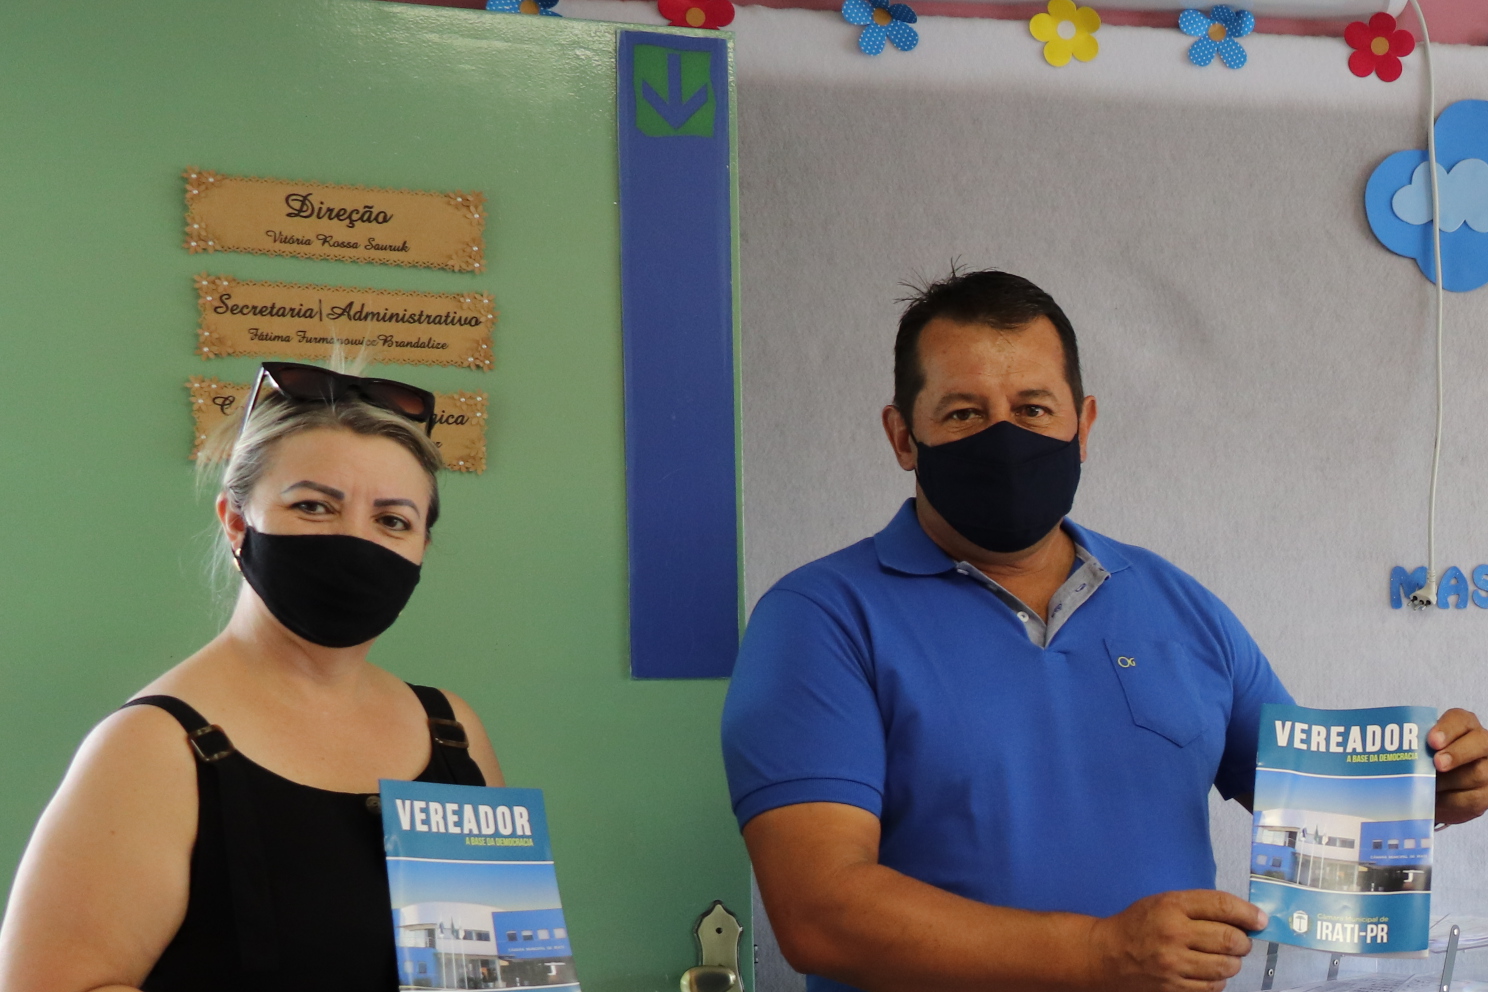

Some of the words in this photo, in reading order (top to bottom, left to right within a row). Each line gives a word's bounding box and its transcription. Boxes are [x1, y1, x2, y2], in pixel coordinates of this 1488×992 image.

[285, 193, 393, 228] Direção
[266, 230, 314, 246] Vitória
[316, 234, 360, 248] Rossa
[326, 301, 482, 327] Administrativo
[248, 328, 293, 343] Fátima
[377, 334, 448, 350] Brandalize
[1274, 720, 1419, 753] VEREADOR
[1352, 754, 1369, 762] BASE
[1369, 754, 1378, 762] DA
[395, 798, 532, 836] VEREADOR
[1316, 921, 1388, 944] IRATI-PR
